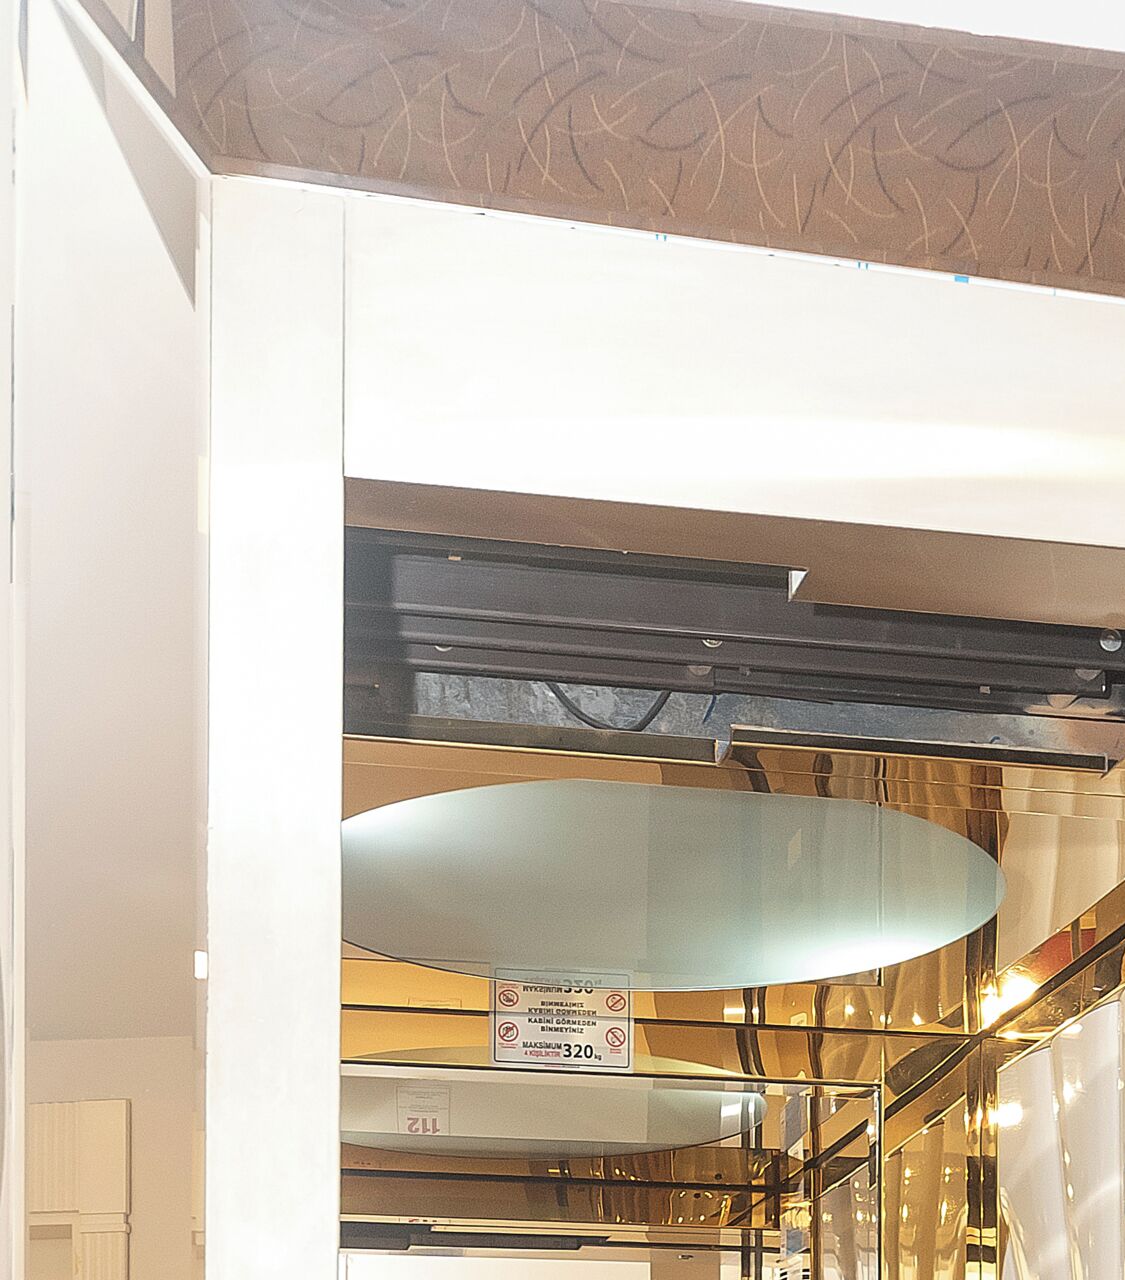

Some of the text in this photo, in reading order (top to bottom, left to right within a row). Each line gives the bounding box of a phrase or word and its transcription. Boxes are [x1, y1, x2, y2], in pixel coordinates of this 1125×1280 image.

[528, 1017, 597, 1027] KABİNİ GÖRMEDEN
[540, 1025, 584, 1034] BİNMEYİNİZ
[522, 1040, 562, 1050] MAKSİMUM
[563, 1043, 594, 1059] 320
